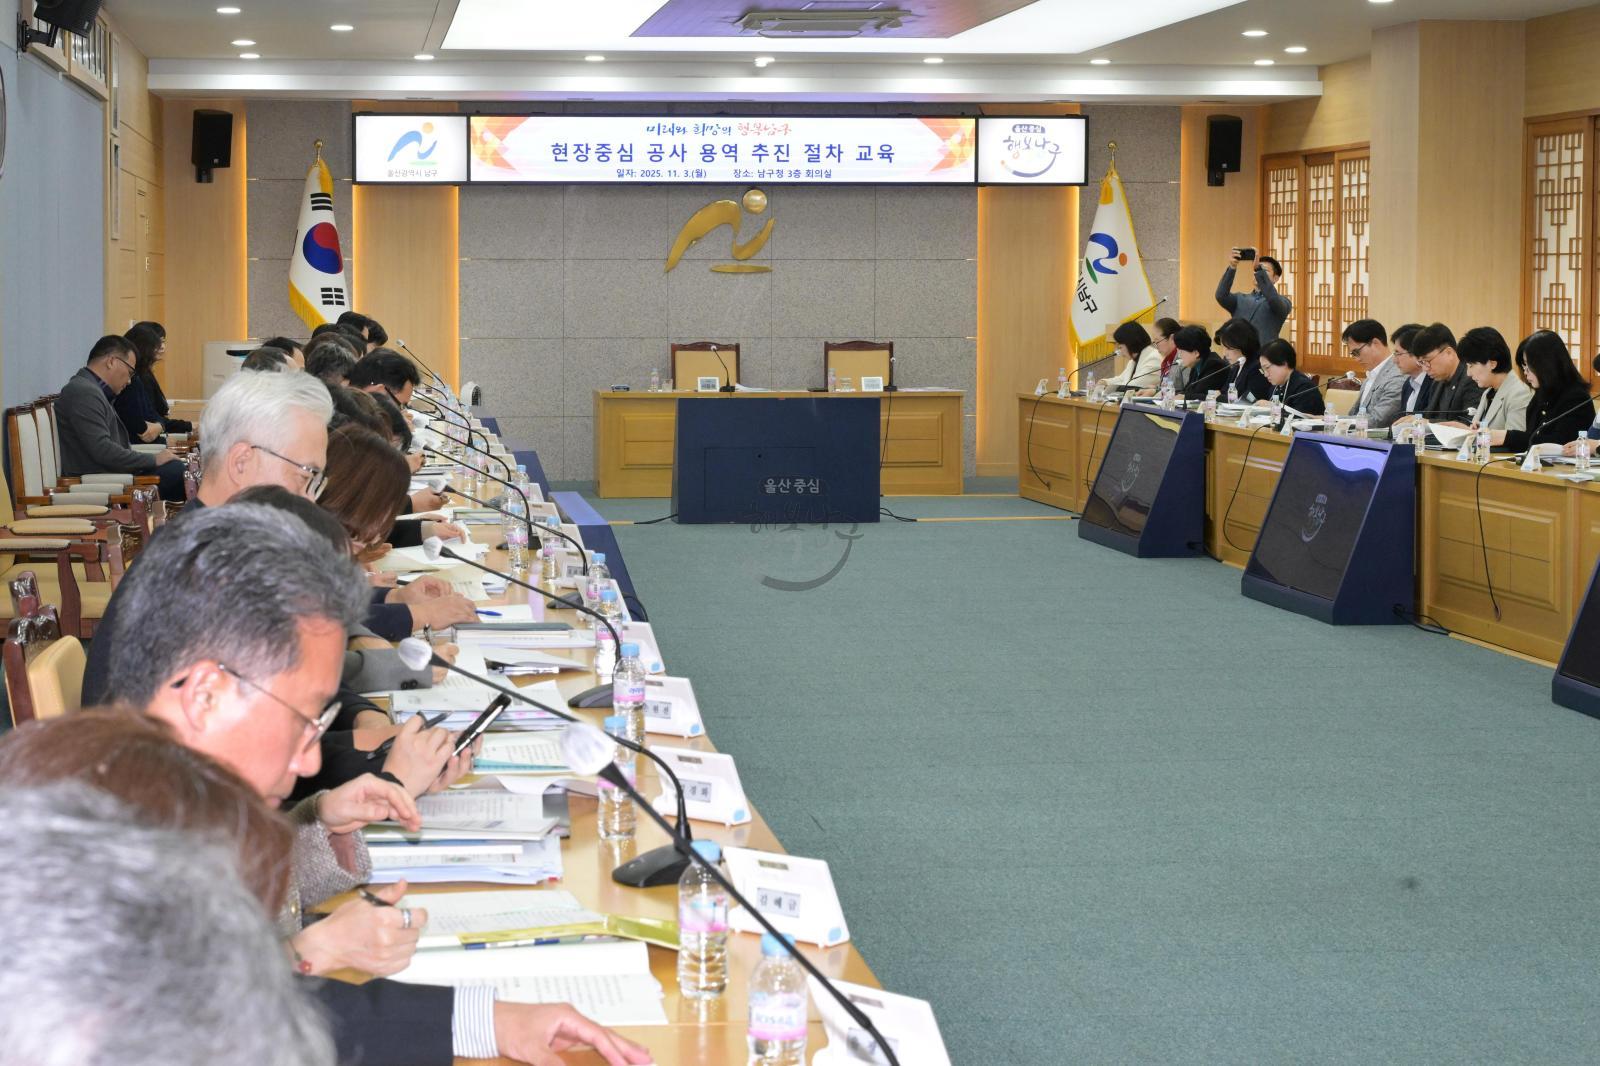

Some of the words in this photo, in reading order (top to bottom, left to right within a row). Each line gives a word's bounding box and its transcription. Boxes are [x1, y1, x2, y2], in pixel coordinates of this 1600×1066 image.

[551, 142, 633, 163] 현장중심
[646, 143, 688, 163] 공사
[699, 143, 738, 163] 용역
[751, 143, 790, 163] 추진
[803, 143, 844, 163] 절차
[855, 143, 895, 163] 교육
[616, 168, 637, 179] 일자:
[640, 168, 664, 179] 2025.
[667, 168, 680, 179] 11.
[683, 168, 707, 179] 3.(월)
[733, 168, 754, 179] 장소:
[757, 168, 784, 179] 남구청
[787, 168, 802, 179] 3층
[805, 168, 833, 179] 회의실
